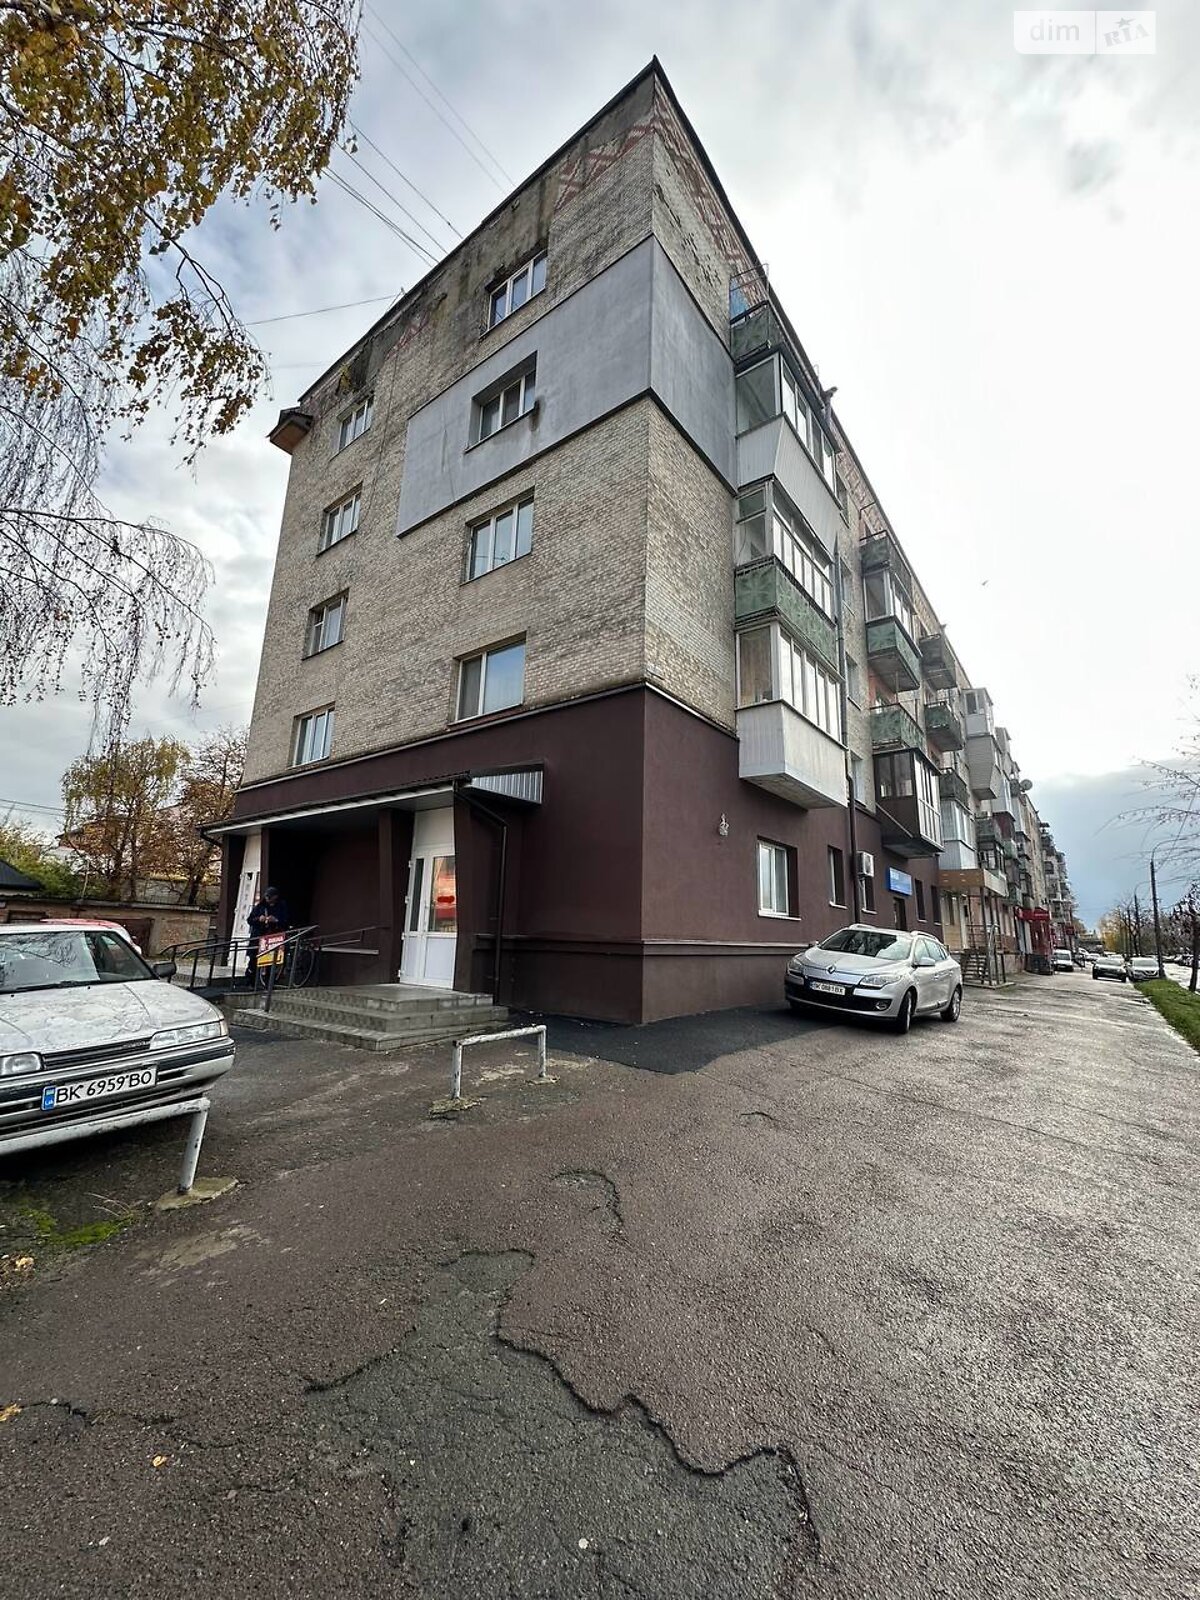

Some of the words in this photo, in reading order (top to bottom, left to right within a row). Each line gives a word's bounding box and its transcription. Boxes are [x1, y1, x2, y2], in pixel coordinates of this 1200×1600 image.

[56, 1085, 80, 1103] BK
[86, 1076, 124, 1096] 6959
[129, 1071, 152, 1087] BO
